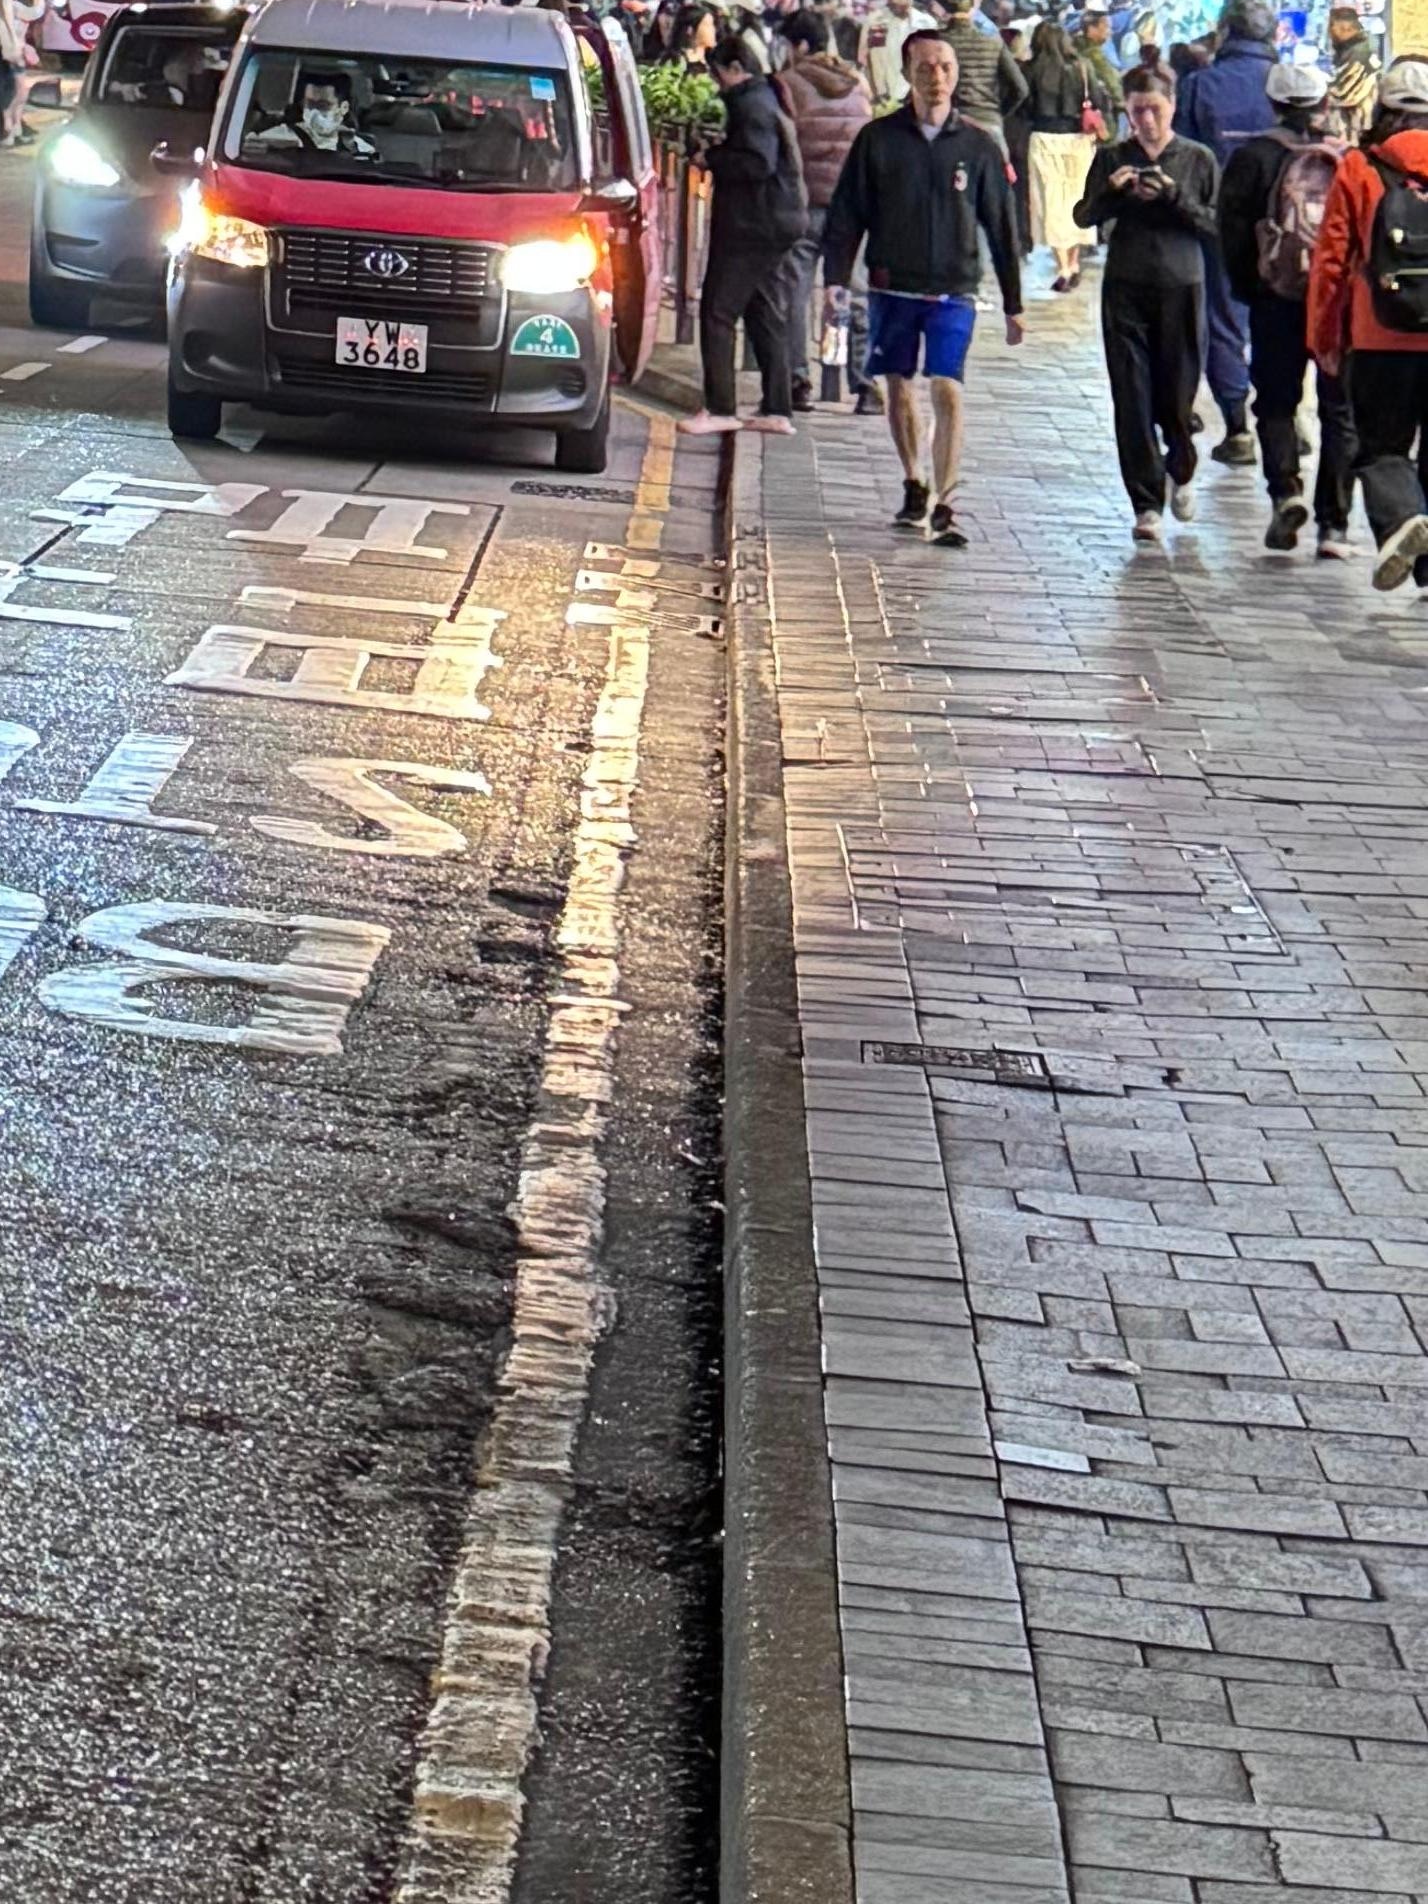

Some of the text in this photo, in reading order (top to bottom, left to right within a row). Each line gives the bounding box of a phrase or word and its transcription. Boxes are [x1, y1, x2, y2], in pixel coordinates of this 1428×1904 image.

[364, 319, 401, 346] YW
[540, 328, 553, 343] 4
[343, 341, 420, 370] 3648
